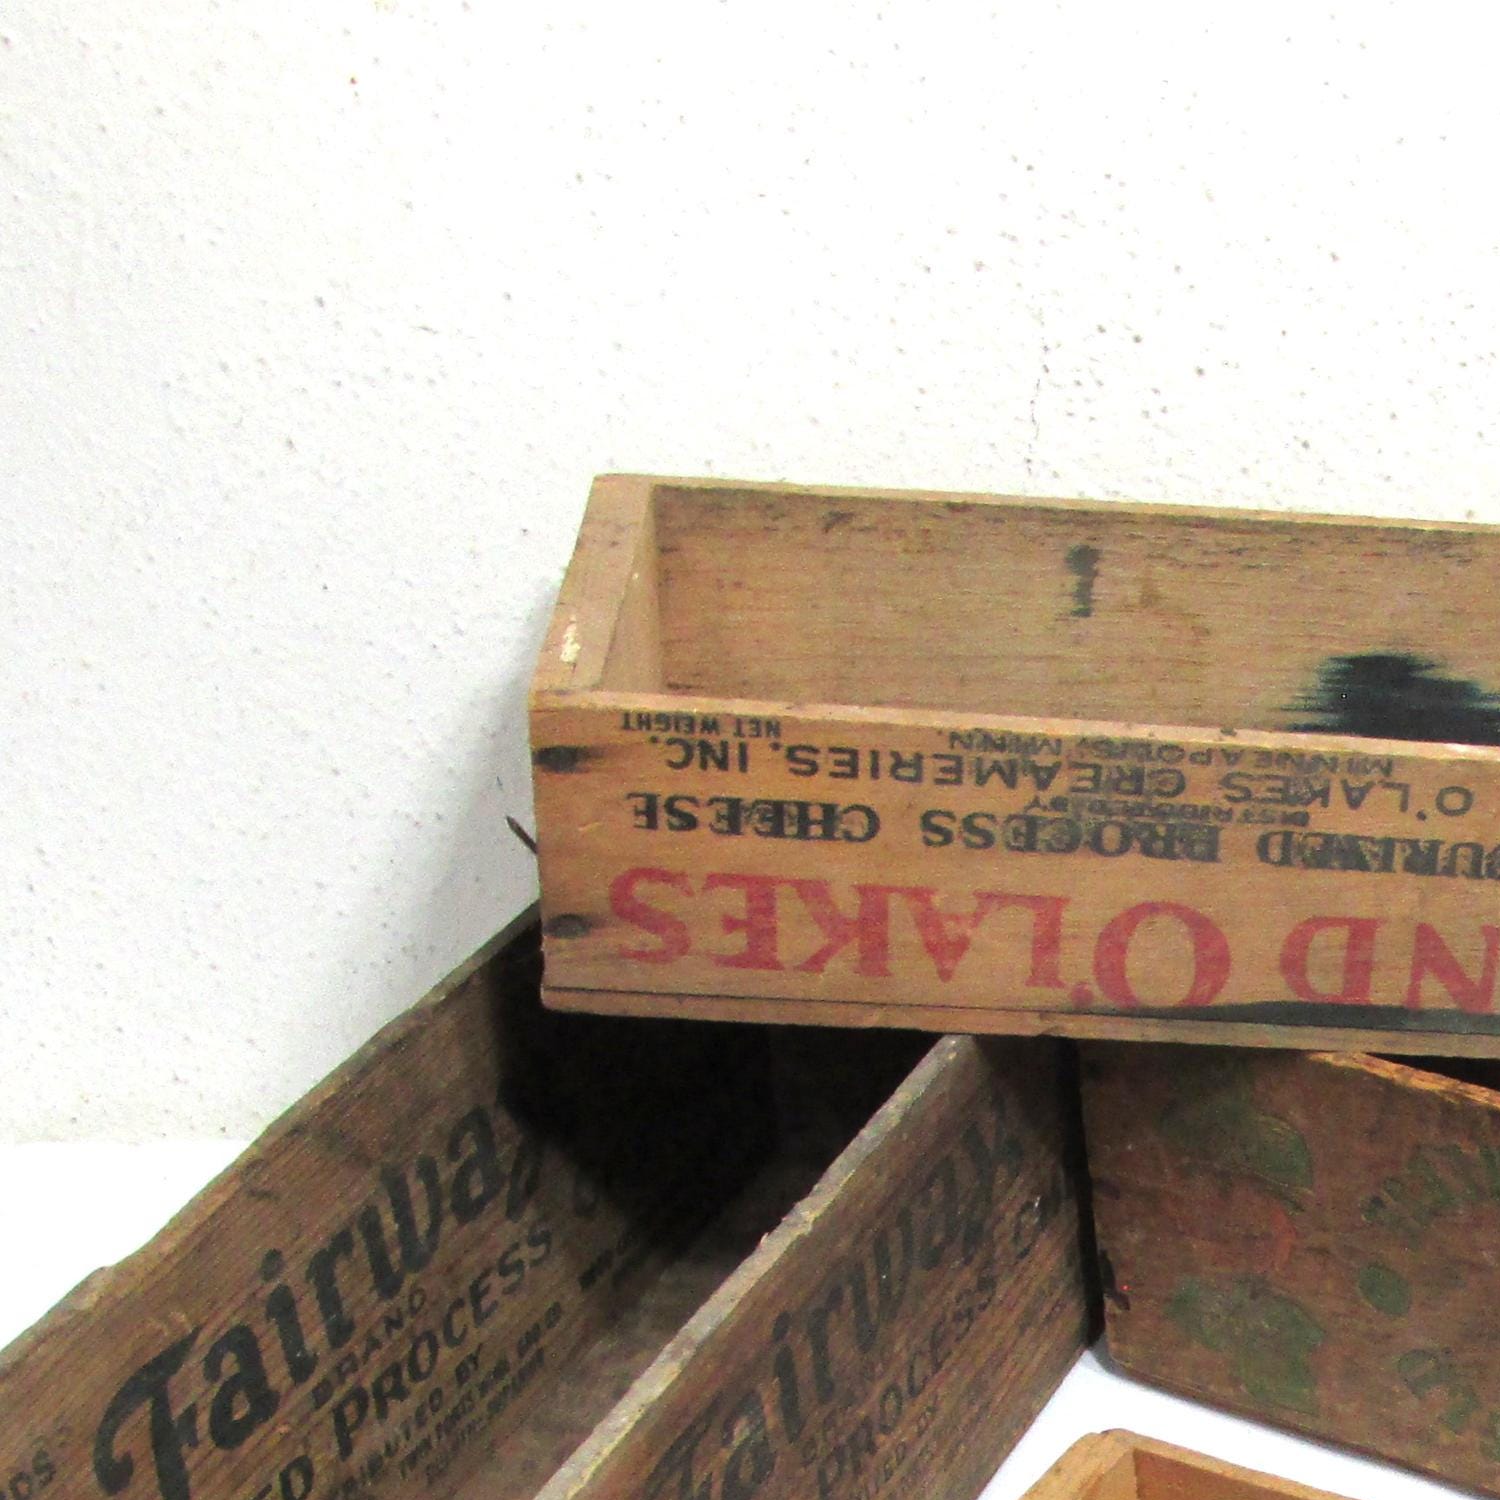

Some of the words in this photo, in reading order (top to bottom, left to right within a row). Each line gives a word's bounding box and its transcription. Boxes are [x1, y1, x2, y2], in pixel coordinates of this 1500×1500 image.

[617, 710, 721, 738] WEIGHT
[731, 716, 783, 740] NET
[648, 735, 748, 775] INC.
[624, 790, 882, 844] CHEESE
[1217, 771, 1475, 822] O'LAKES
[919, 808, 1220, 864] PROCESS
[607, 867, 1231, 1011] O'LAKES
[331, 1225, 556, 1461] PROCESS
